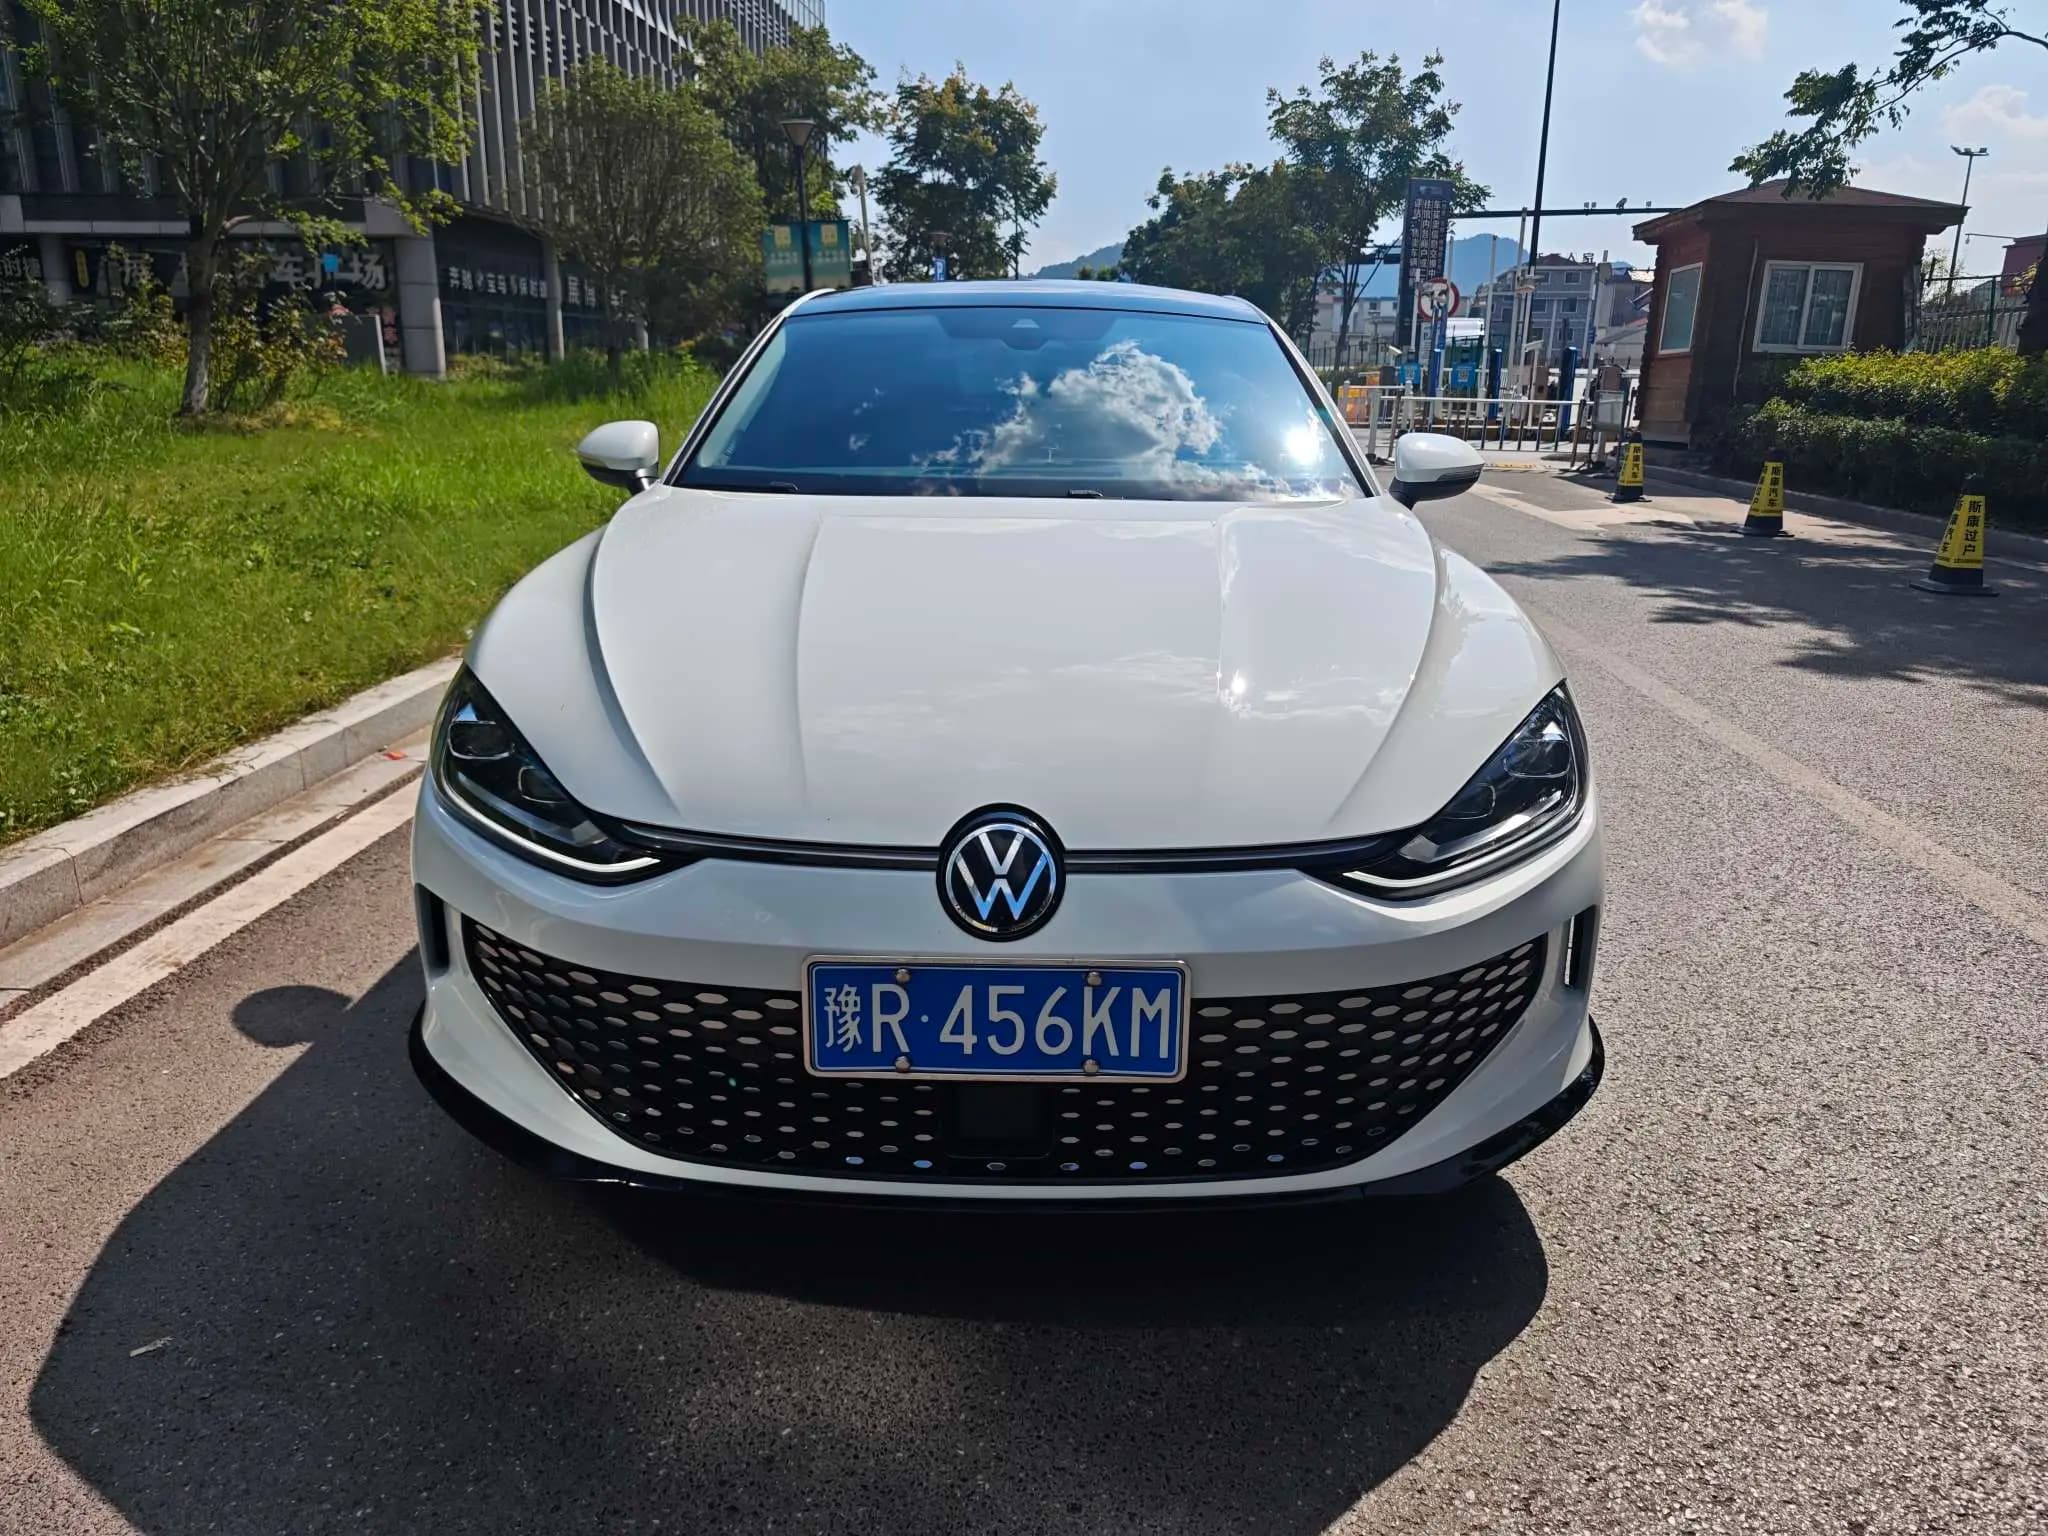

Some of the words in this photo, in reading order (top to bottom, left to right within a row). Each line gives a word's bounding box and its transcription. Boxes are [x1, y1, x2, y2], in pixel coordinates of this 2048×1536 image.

[1767, 465, 1782, 508] 斯康汽车
[1962, 500, 1982, 556] 斯康过户
